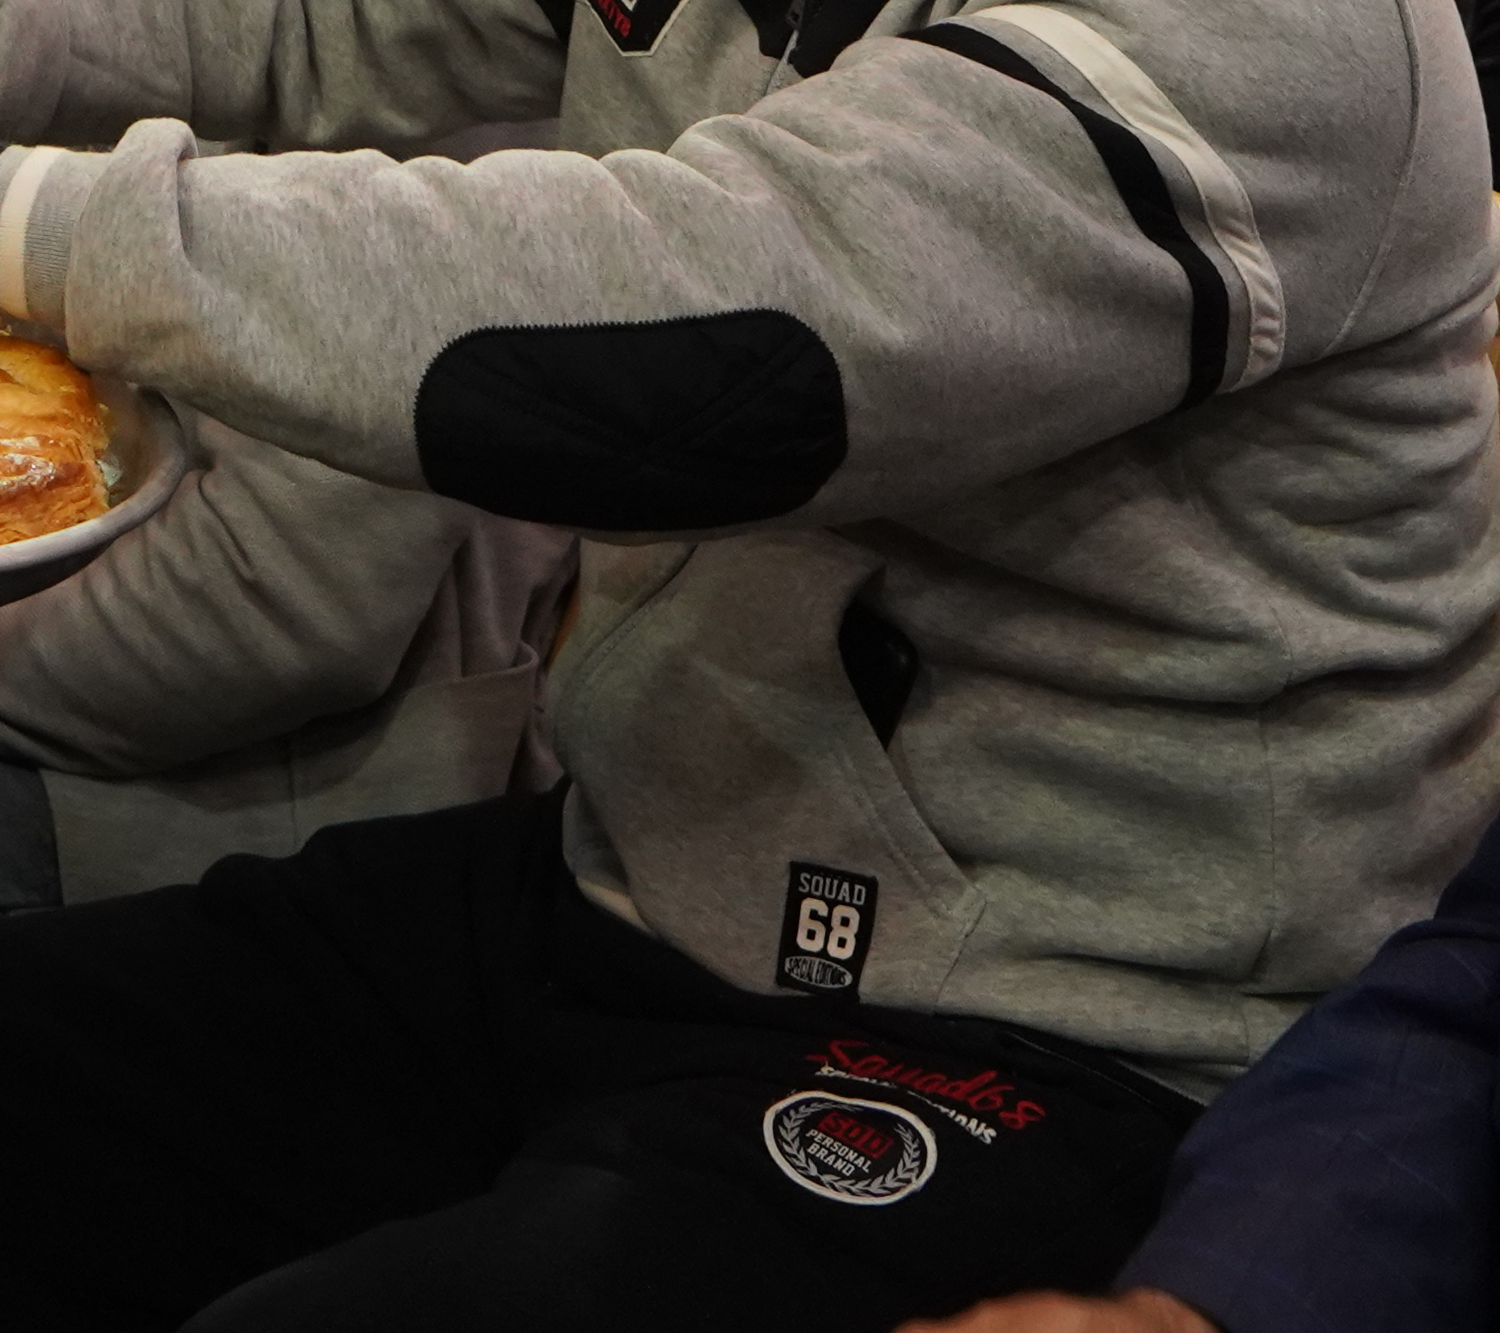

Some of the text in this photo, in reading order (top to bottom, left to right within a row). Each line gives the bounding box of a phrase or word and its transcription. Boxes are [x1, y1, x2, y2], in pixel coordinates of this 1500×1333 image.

[798, 872, 867, 905] SQUAD
[796, 896, 860, 961] 68
[805, 1127, 873, 1174] PERSONAL
[806, 1141, 856, 1177] BRAND
